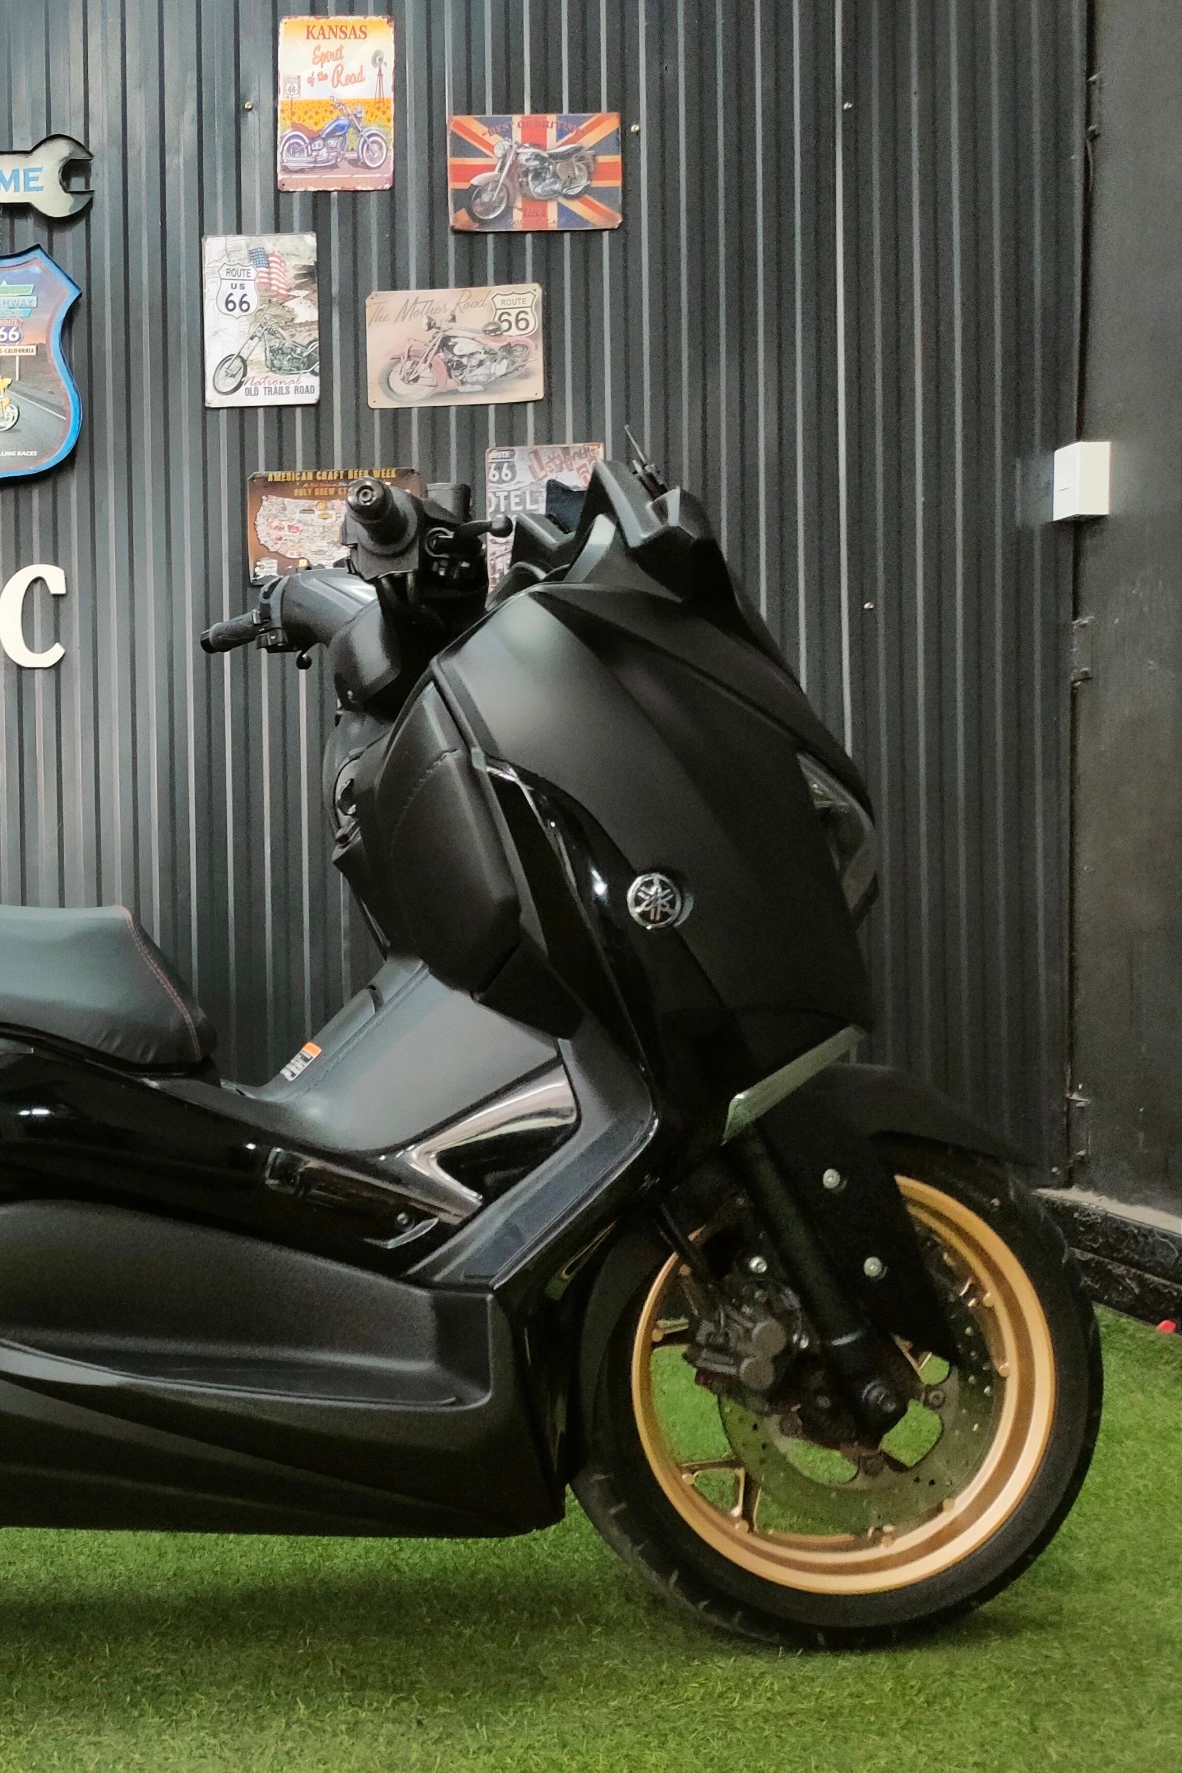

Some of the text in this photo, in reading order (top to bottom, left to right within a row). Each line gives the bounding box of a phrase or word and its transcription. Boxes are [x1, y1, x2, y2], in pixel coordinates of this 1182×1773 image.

[305, 24, 368, 40] KANSAS
[312, 44, 344, 68] Spirit
[307, 63, 366, 88] of the Road
[225, 268, 251, 278] ROUTE
[230, 282, 245, 290] US
[224, 292, 251, 313] 66
[369, 289, 491, 327] The Mother Road
[499, 297, 527, 307] ROUTE
[497, 310, 530, 333] 66
[242, 372, 302, 387] National
[244, 384, 316, 397] OLD TRAILS ROAD
[267, 471, 314, 482] AMERICAN
[316, 470, 345, 481] CRAFT
[372, 468, 397, 479] WEEK
[488, 462, 512, 482] 66
